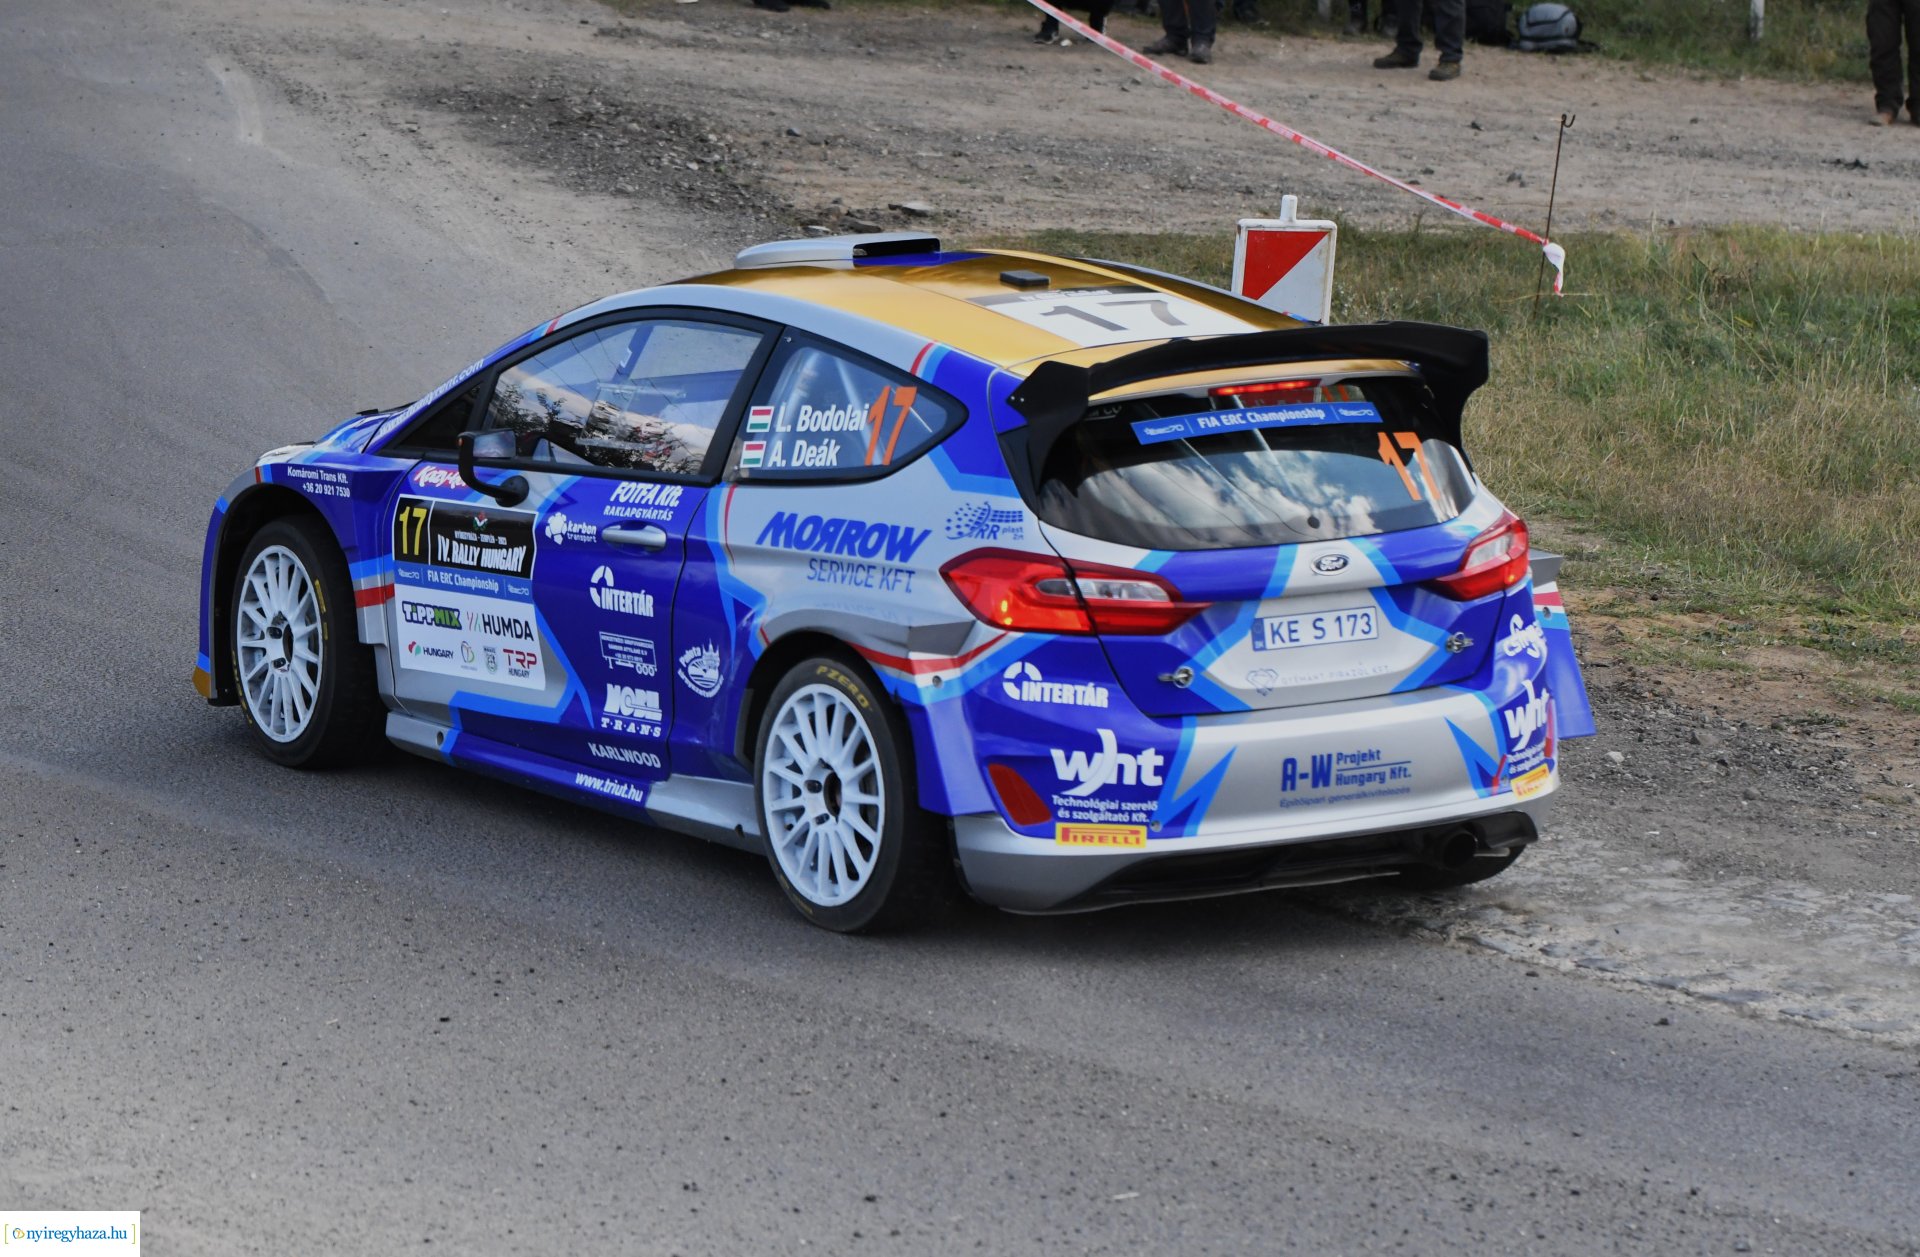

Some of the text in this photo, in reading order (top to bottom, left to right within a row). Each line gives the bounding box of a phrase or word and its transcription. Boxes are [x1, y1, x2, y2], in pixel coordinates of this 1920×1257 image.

[1040, 300, 1188, 331] 17
[775, 402, 870, 433] L. Bodolai
[864, 385, 918, 467] 17
[1197, 413, 1220, 430] FIA
[1221, 411, 1246, 427] ERC
[1247, 406, 1326, 426] Championship
[767, 438, 841, 468] A. Deák
[1377, 431, 1442, 501] 17
[287, 466, 349, 484] Komáromi Trans Kft.
[302, 483, 350, 498] +36 20 921 7530
[610, 481, 660, 505] FOTFA
[603, 505, 674, 521] RAKLAPGYÁRTÁS
[399, 506, 428, 556] 17
[567, 520, 597, 534] karbon
[567, 532, 597, 543] transport
[755, 511, 933, 564] MORROW
[437, 534, 526, 573] IV. RALLY HUNGARY
[427, 569, 440, 582] FIA
[440, 571, 453, 585] ERC
[454, 573, 499, 594] Championship
[807, 557, 875, 589] SERVICE
[601, 587, 654, 618] INTERTÁR
[481, 613, 534, 642] HUMDA
[1270, 612, 1372, 645] KE S 173
[422, 646, 454, 659] HUNGARY
[502, 648, 537, 670] TRP
[509, 668, 530, 678] HUNGARY
[827, 667, 871, 709] ZERO
[1021, 682, 1109, 708] INTERTÁR
[587, 742, 661, 768] KARLWOOD
[1336, 749, 1381, 766] Projekt
[1281, 753, 1333, 792] A-W
[1335, 766, 1412, 787] Hungary Kft.
[575, 772, 643, 803] www.triut.hu
[1052, 795, 1159, 812] Technológiai szerelő
[1057, 808, 1150, 824] és szolgáltató Kft.
[1061, 826, 1142, 846] PIRELLI
